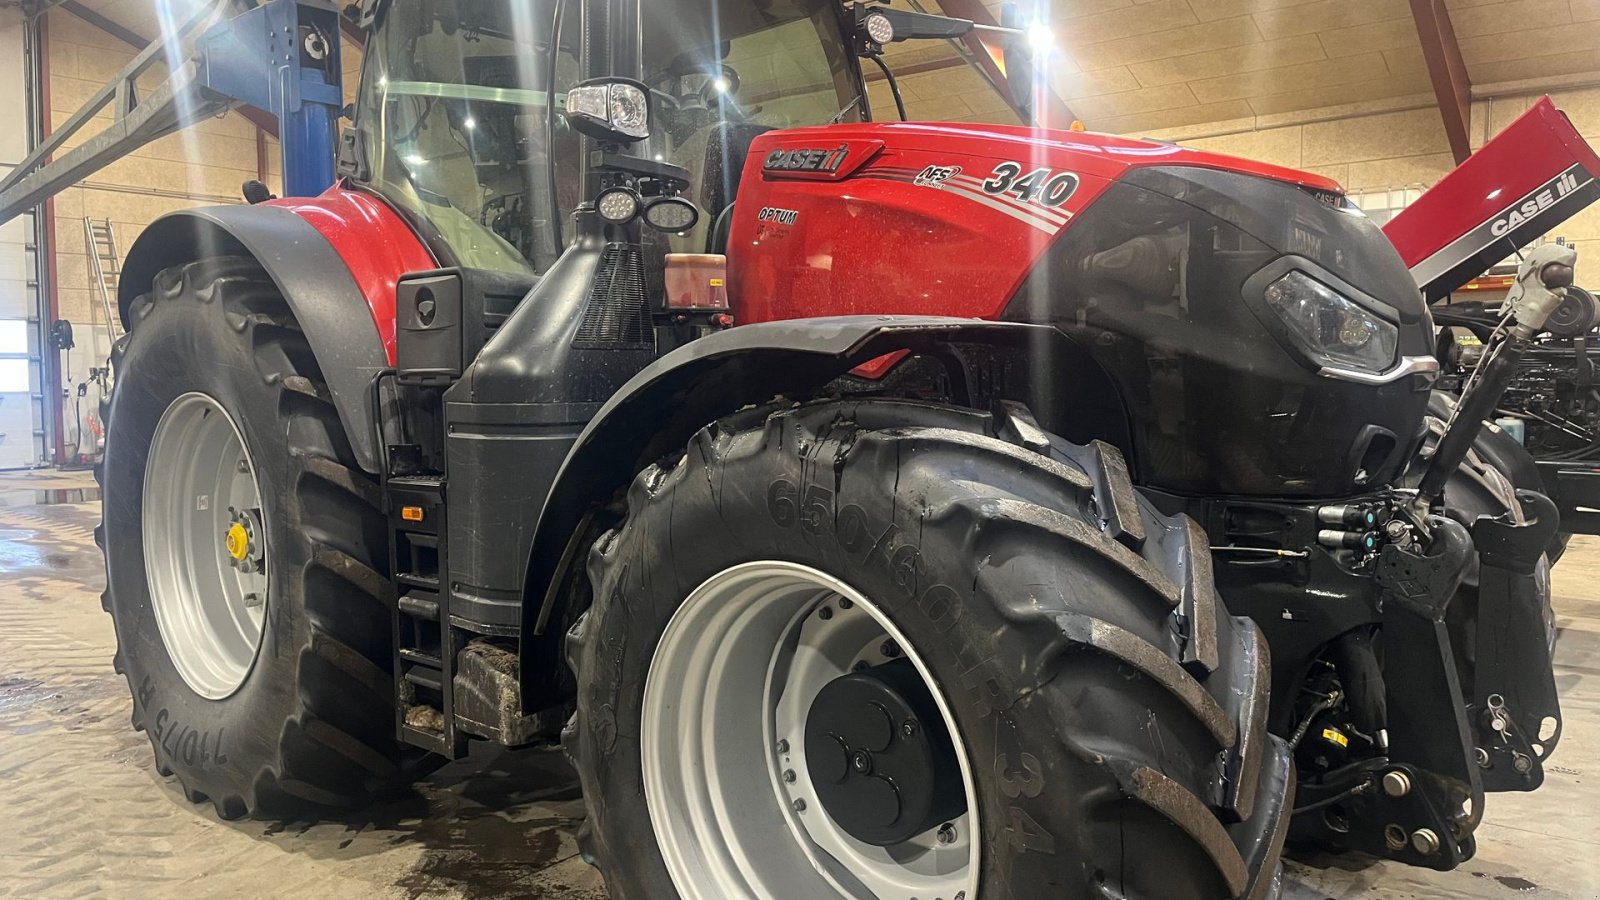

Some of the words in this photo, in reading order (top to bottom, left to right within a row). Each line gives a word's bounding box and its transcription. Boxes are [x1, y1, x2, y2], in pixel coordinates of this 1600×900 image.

[764, 149, 827, 172] CASE
[917, 165, 952, 181] AFS
[981, 161, 1080, 208] 340
[1315, 191, 1335, 207] CASE
[758, 206, 799, 225] OPTUM
[1490, 188, 1554, 237] CASE
[154, 708, 228, 770] 710/75
